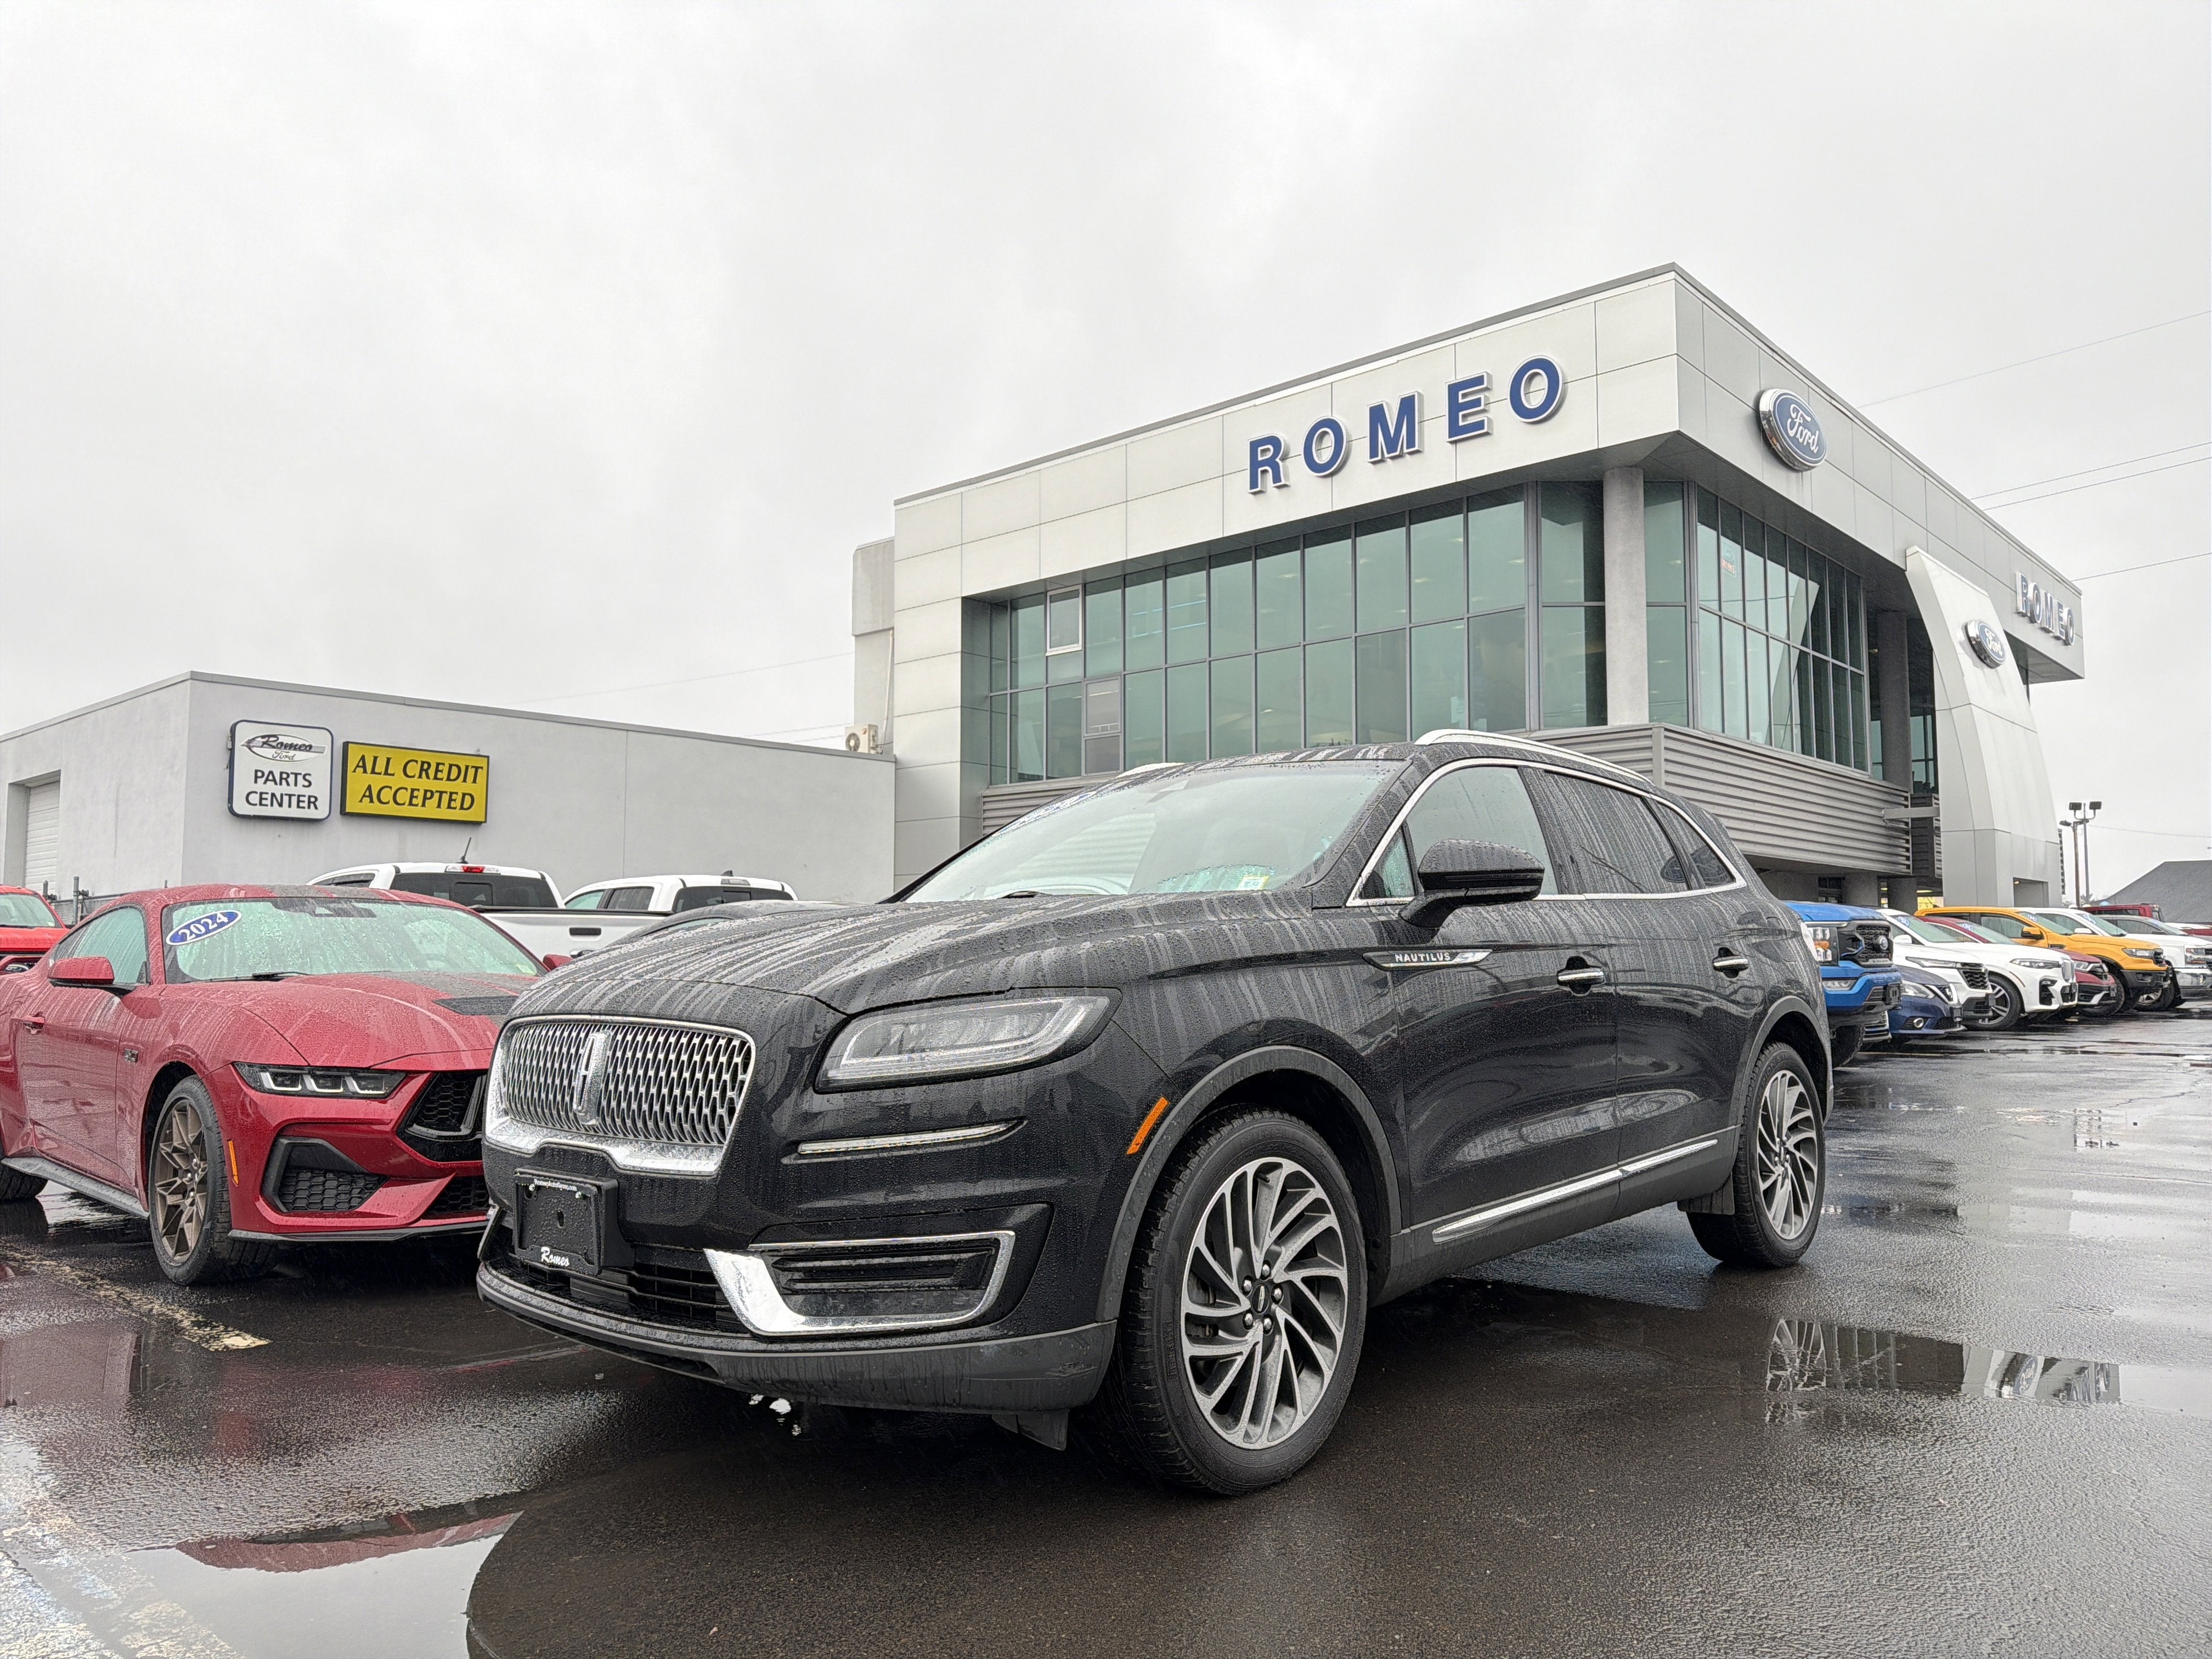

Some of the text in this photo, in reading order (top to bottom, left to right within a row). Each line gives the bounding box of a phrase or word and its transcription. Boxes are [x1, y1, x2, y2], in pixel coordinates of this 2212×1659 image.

[1248, 354, 1566, 495] ROMEO
[1787, 404, 1819, 454] Ford
[2016, 572, 2075, 646] ROMEO
[1985, 628, 2002, 655] Ford
[261, 735, 313, 751] Romeo
[272, 750, 296, 760] Ford
[253, 769, 312, 788] PARTS
[352, 754, 483, 785] ALL CREDIT
[245, 791, 318, 810] CENTER
[359, 784, 476, 811] ACCEPTED
[178, 912, 229, 941] 2024
[1395, 952, 1451, 963] NAUTILUS
